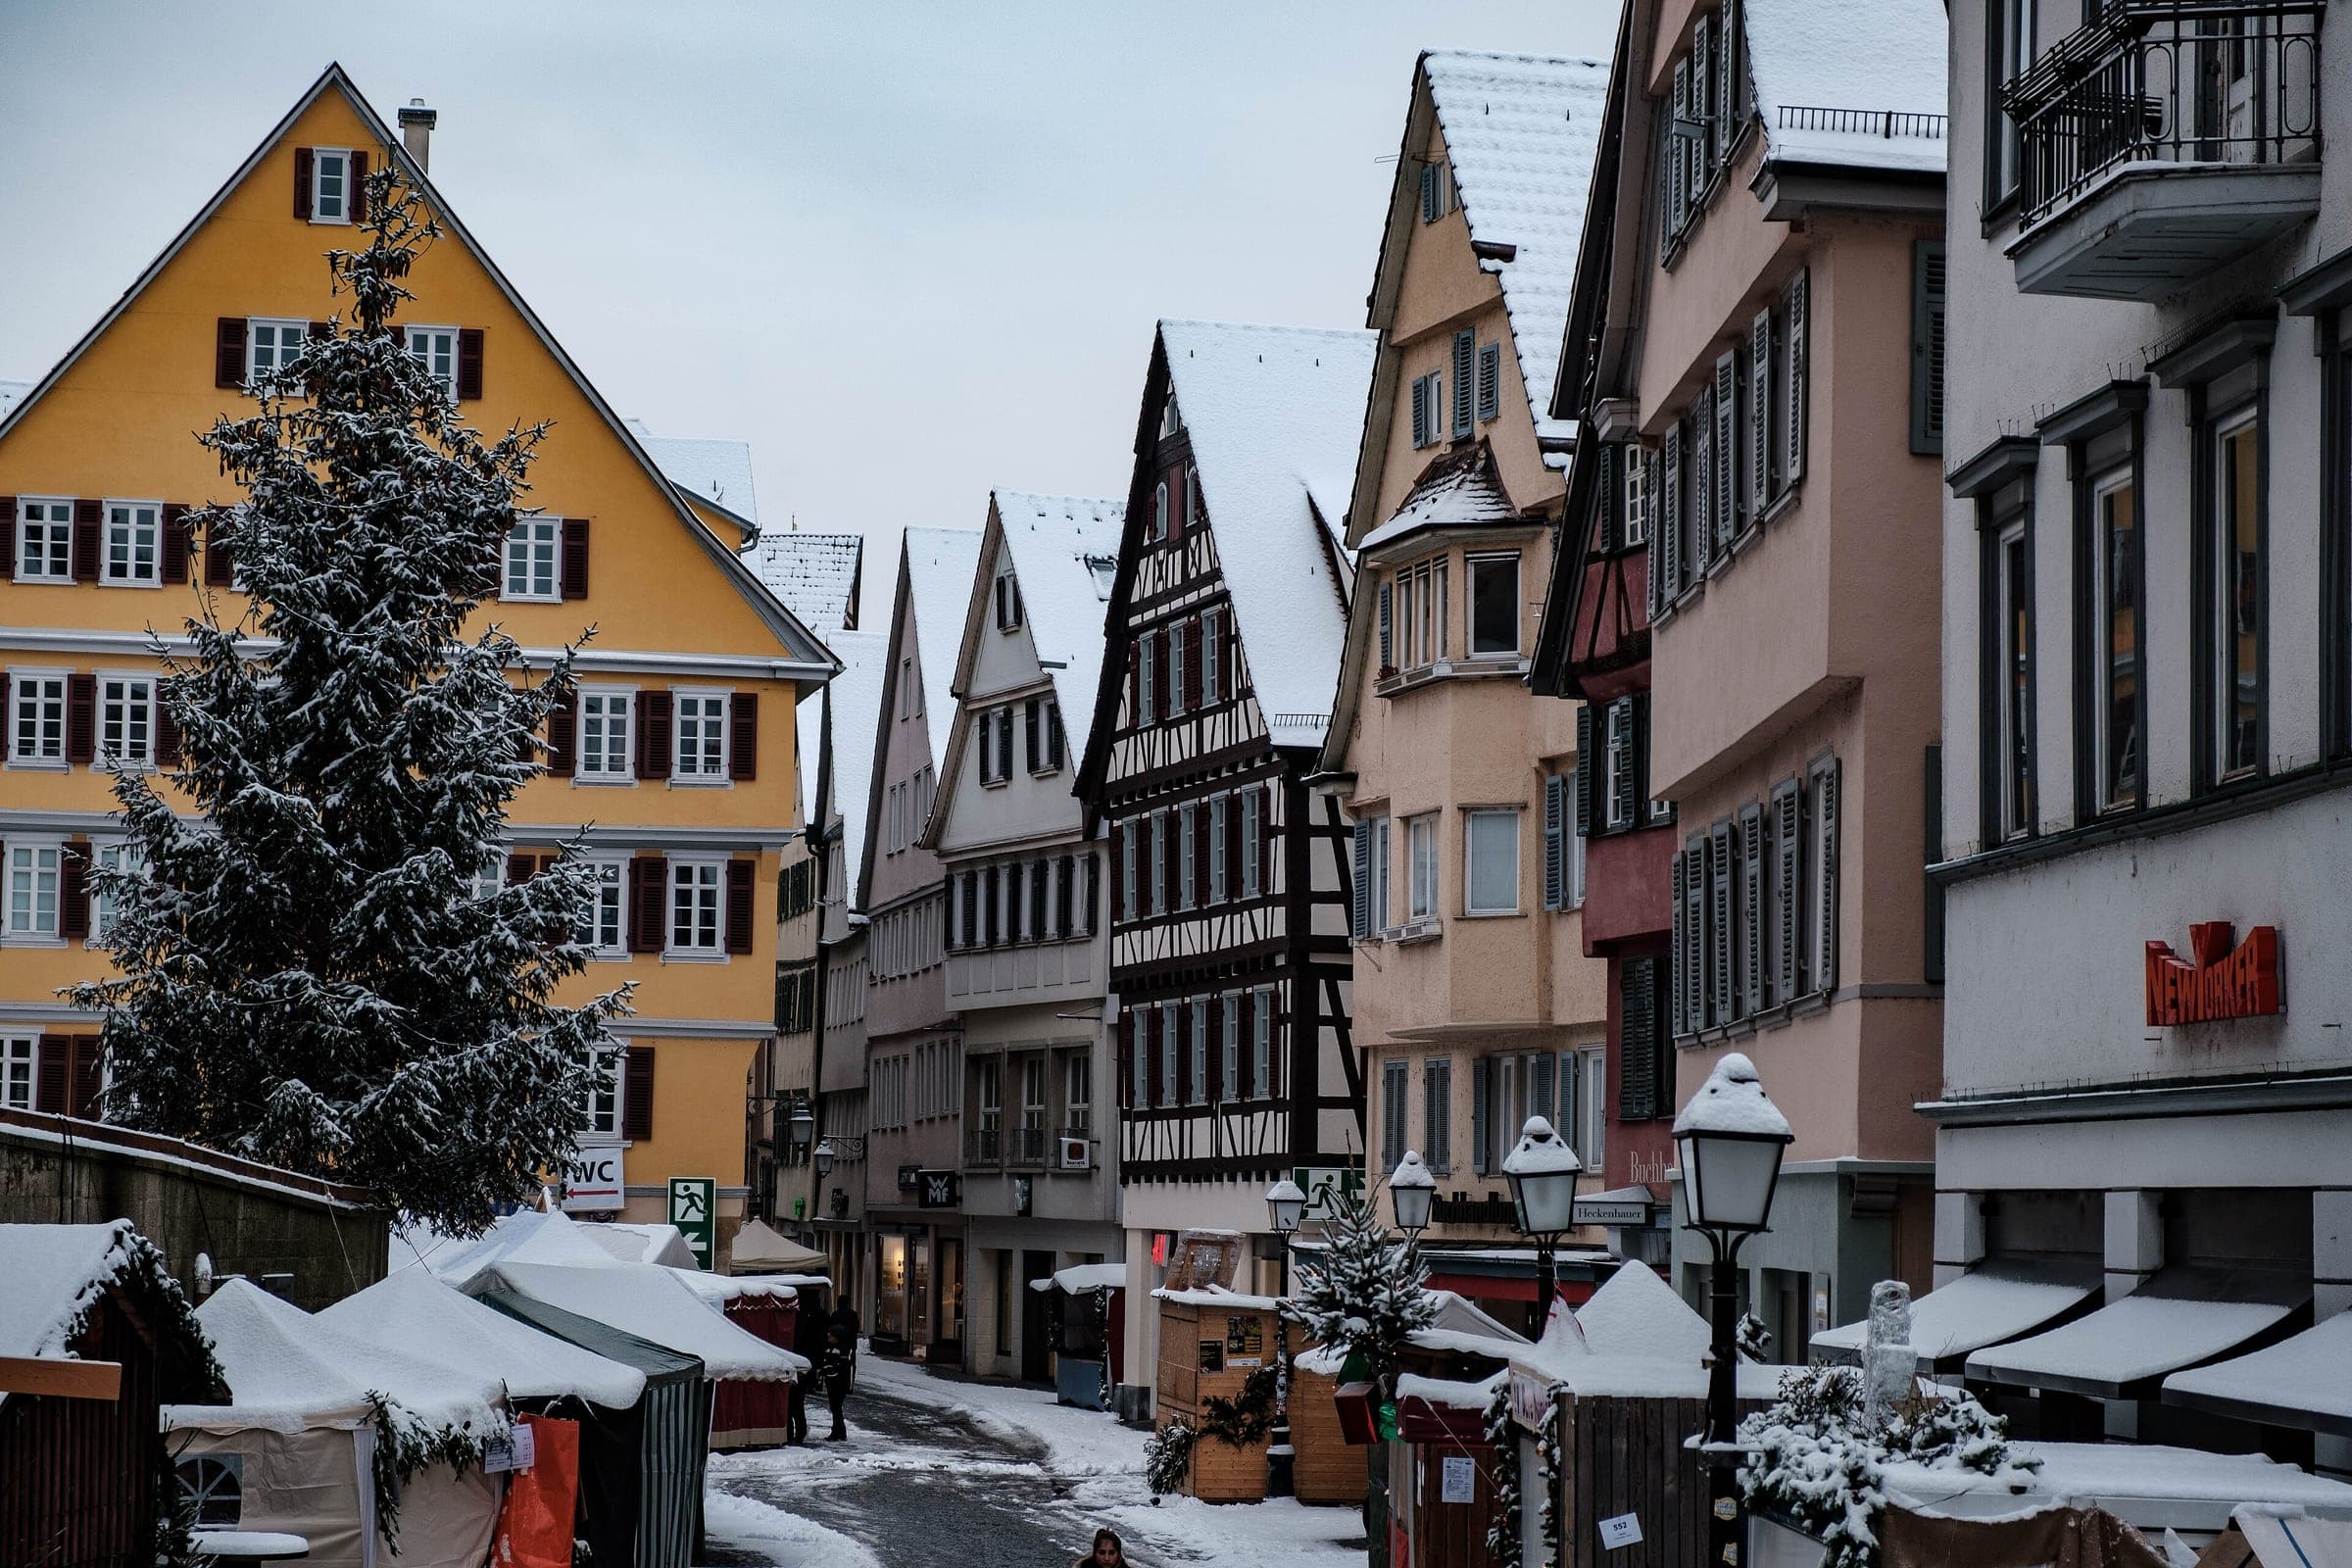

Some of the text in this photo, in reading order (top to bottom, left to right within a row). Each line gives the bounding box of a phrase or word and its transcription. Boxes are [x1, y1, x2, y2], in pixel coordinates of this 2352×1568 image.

[570, 1160, 614, 1183] WC
[1432, 1191, 1516, 1224] Buchhandlun
[1578, 1207, 1642, 1219] Heckenhauer
[1613, 1521, 1628, 1532] 552
